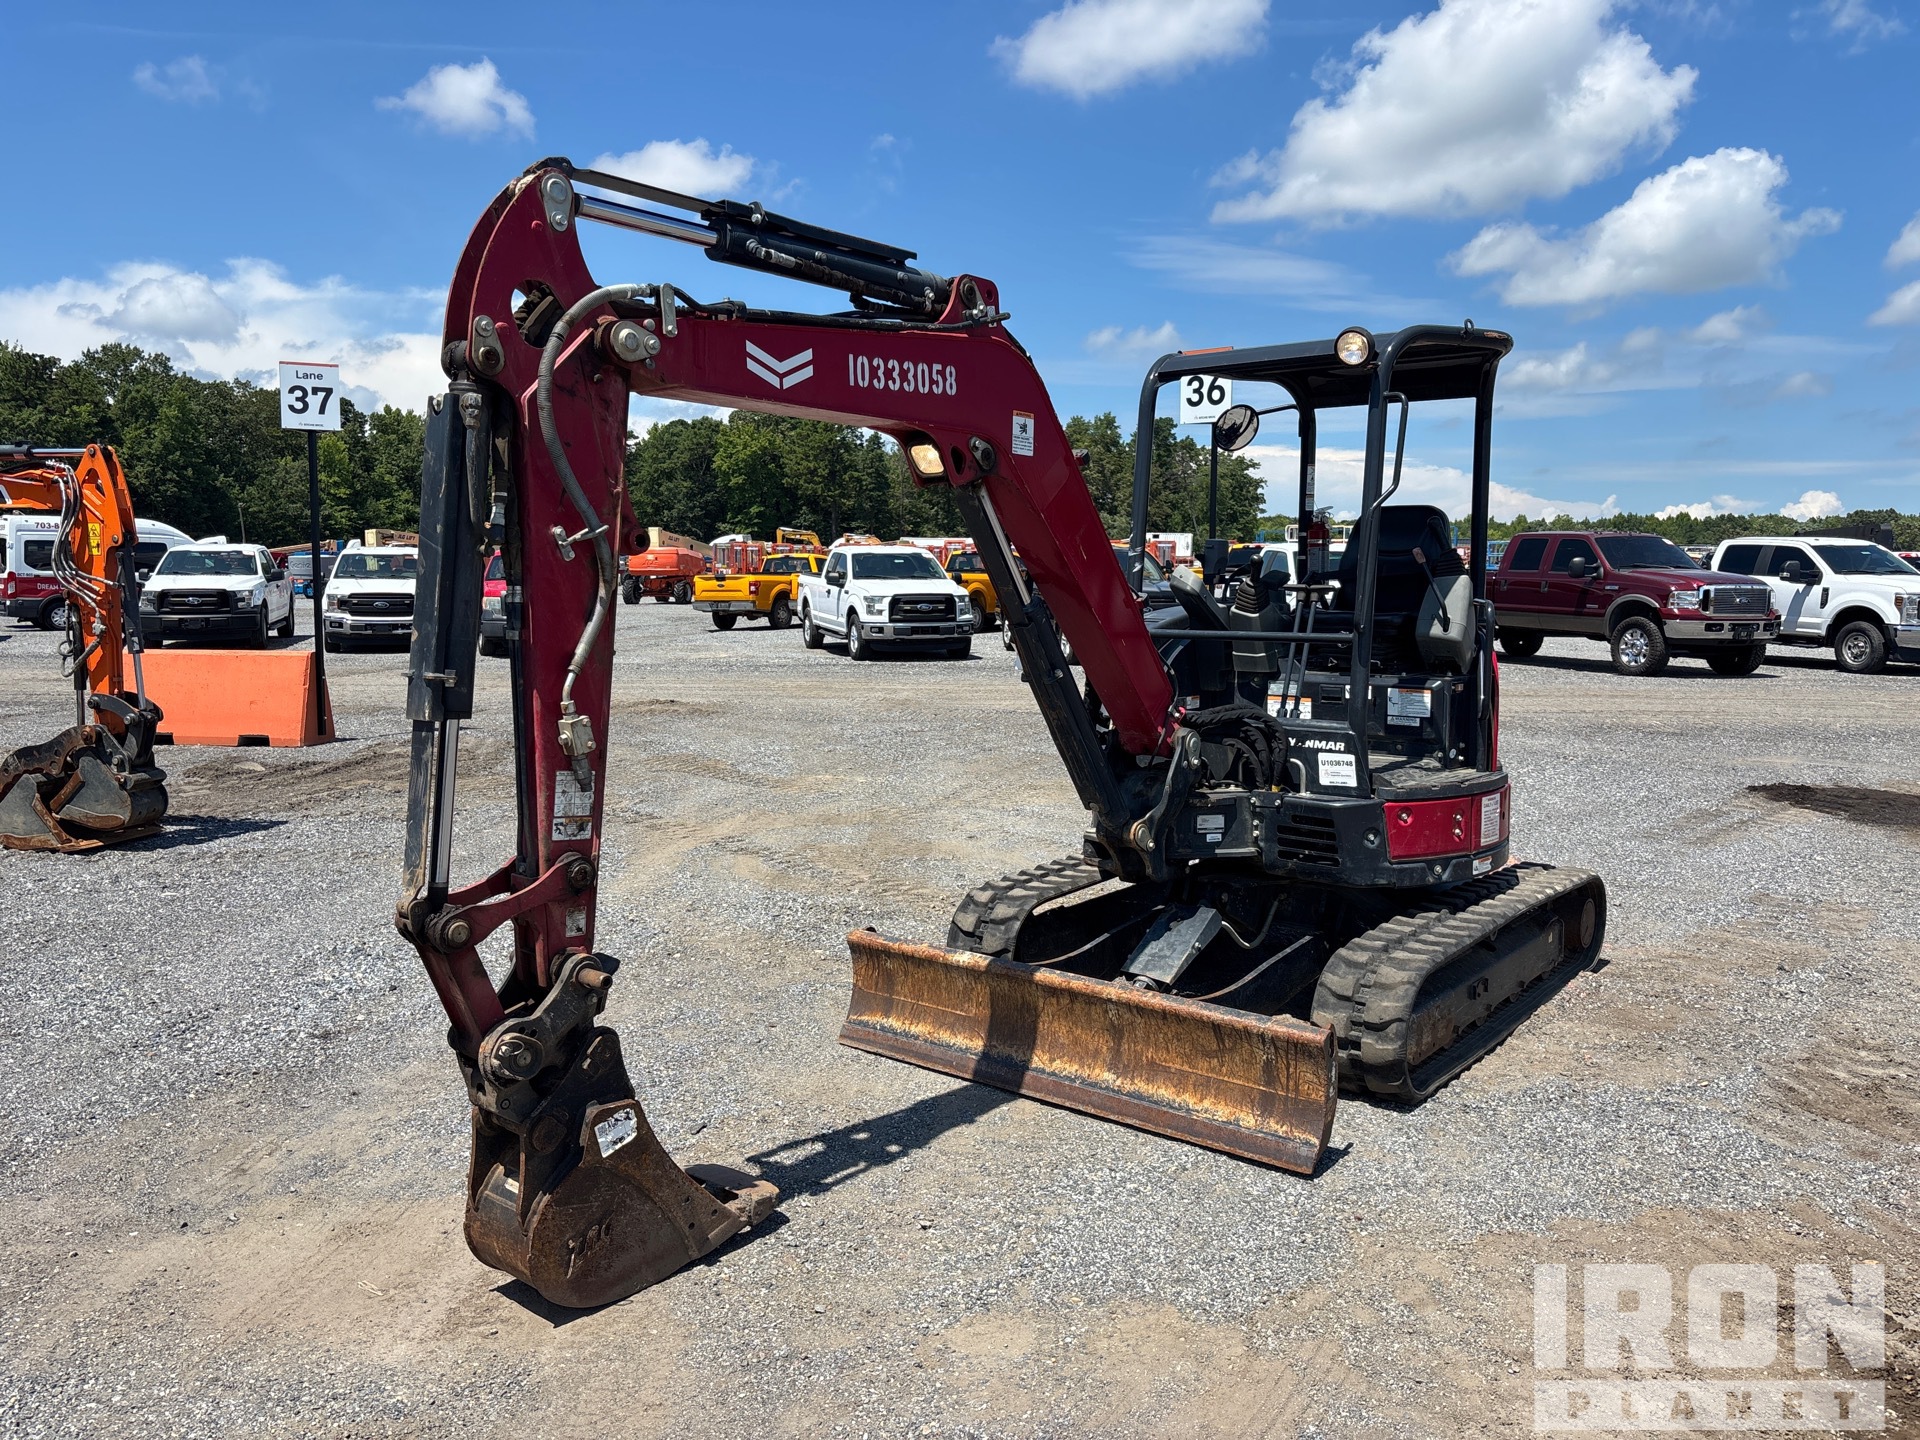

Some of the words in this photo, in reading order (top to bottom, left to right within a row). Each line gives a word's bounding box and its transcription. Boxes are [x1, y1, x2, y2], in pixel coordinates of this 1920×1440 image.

[295, 369, 324, 381] Lane
[287, 384, 334, 415] 37
[1185, 375, 1226, 408] 36
[1288, 737, 1345, 751] YNMAR
